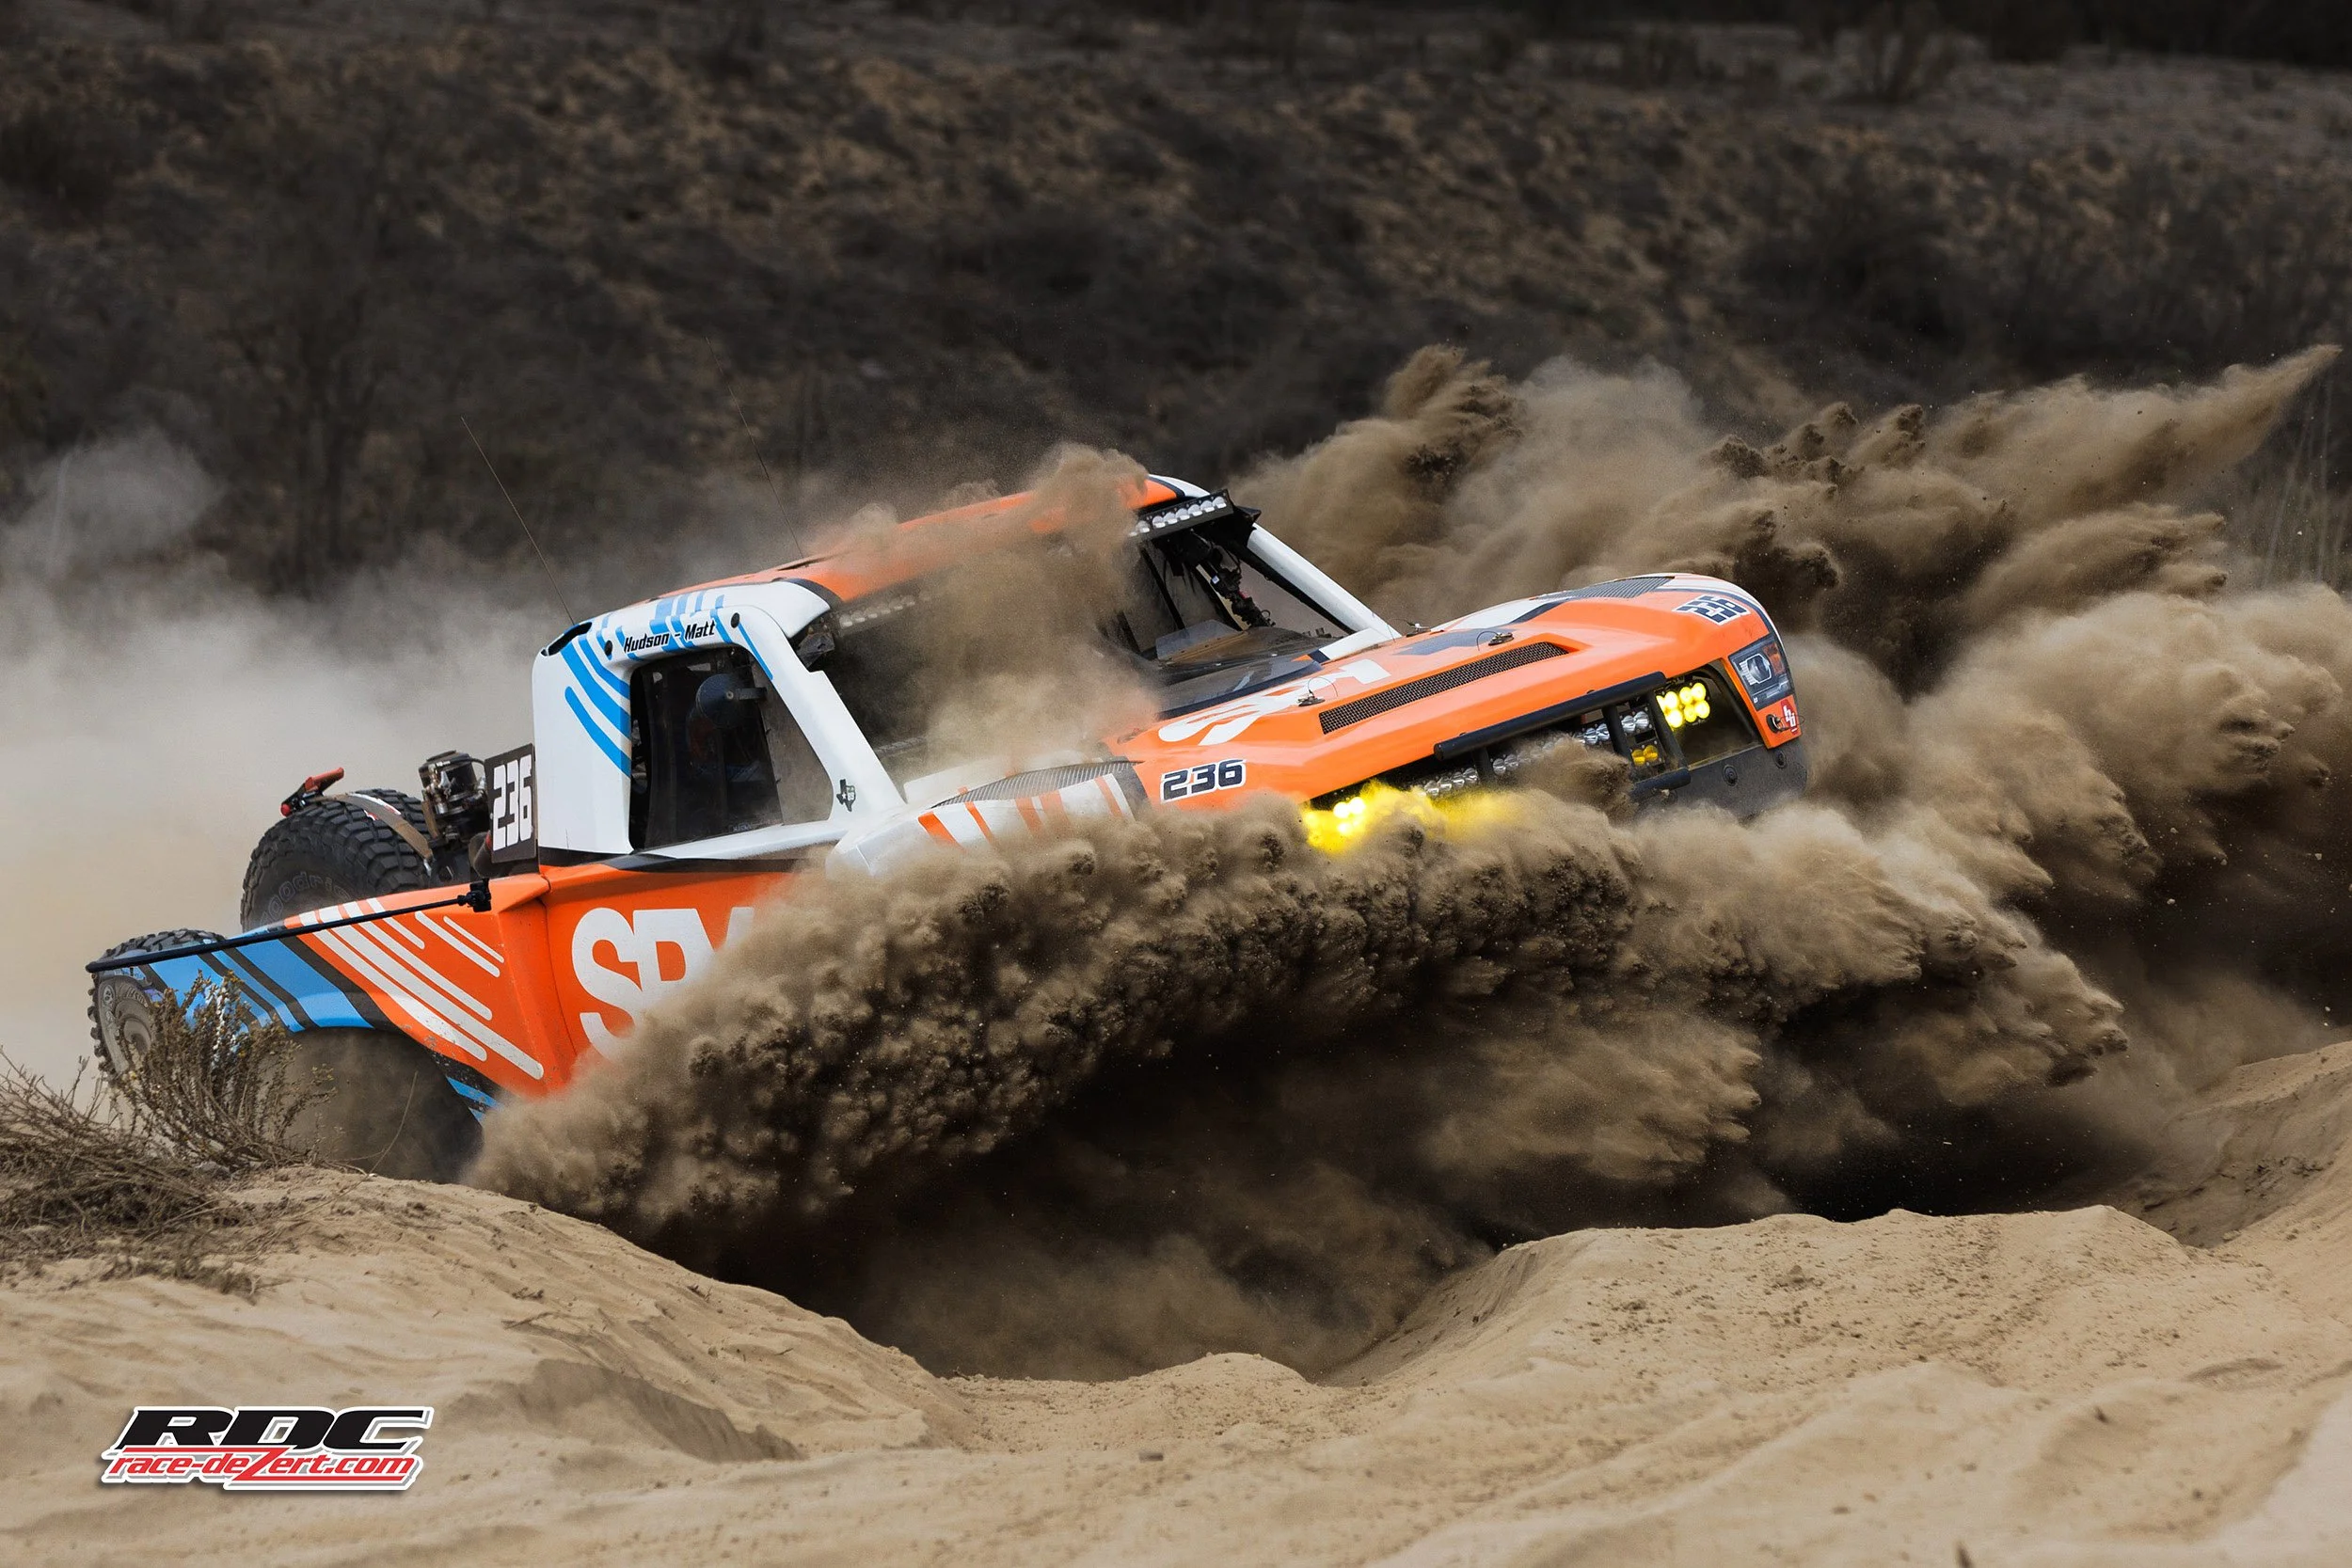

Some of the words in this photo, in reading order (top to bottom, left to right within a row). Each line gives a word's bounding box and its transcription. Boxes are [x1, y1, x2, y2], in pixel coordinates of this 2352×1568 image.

[623, 633, 670, 653] Hudson
[685, 620, 716, 641] Matt
[1162, 758, 1246, 802] 236
[493, 754, 532, 851] 236
